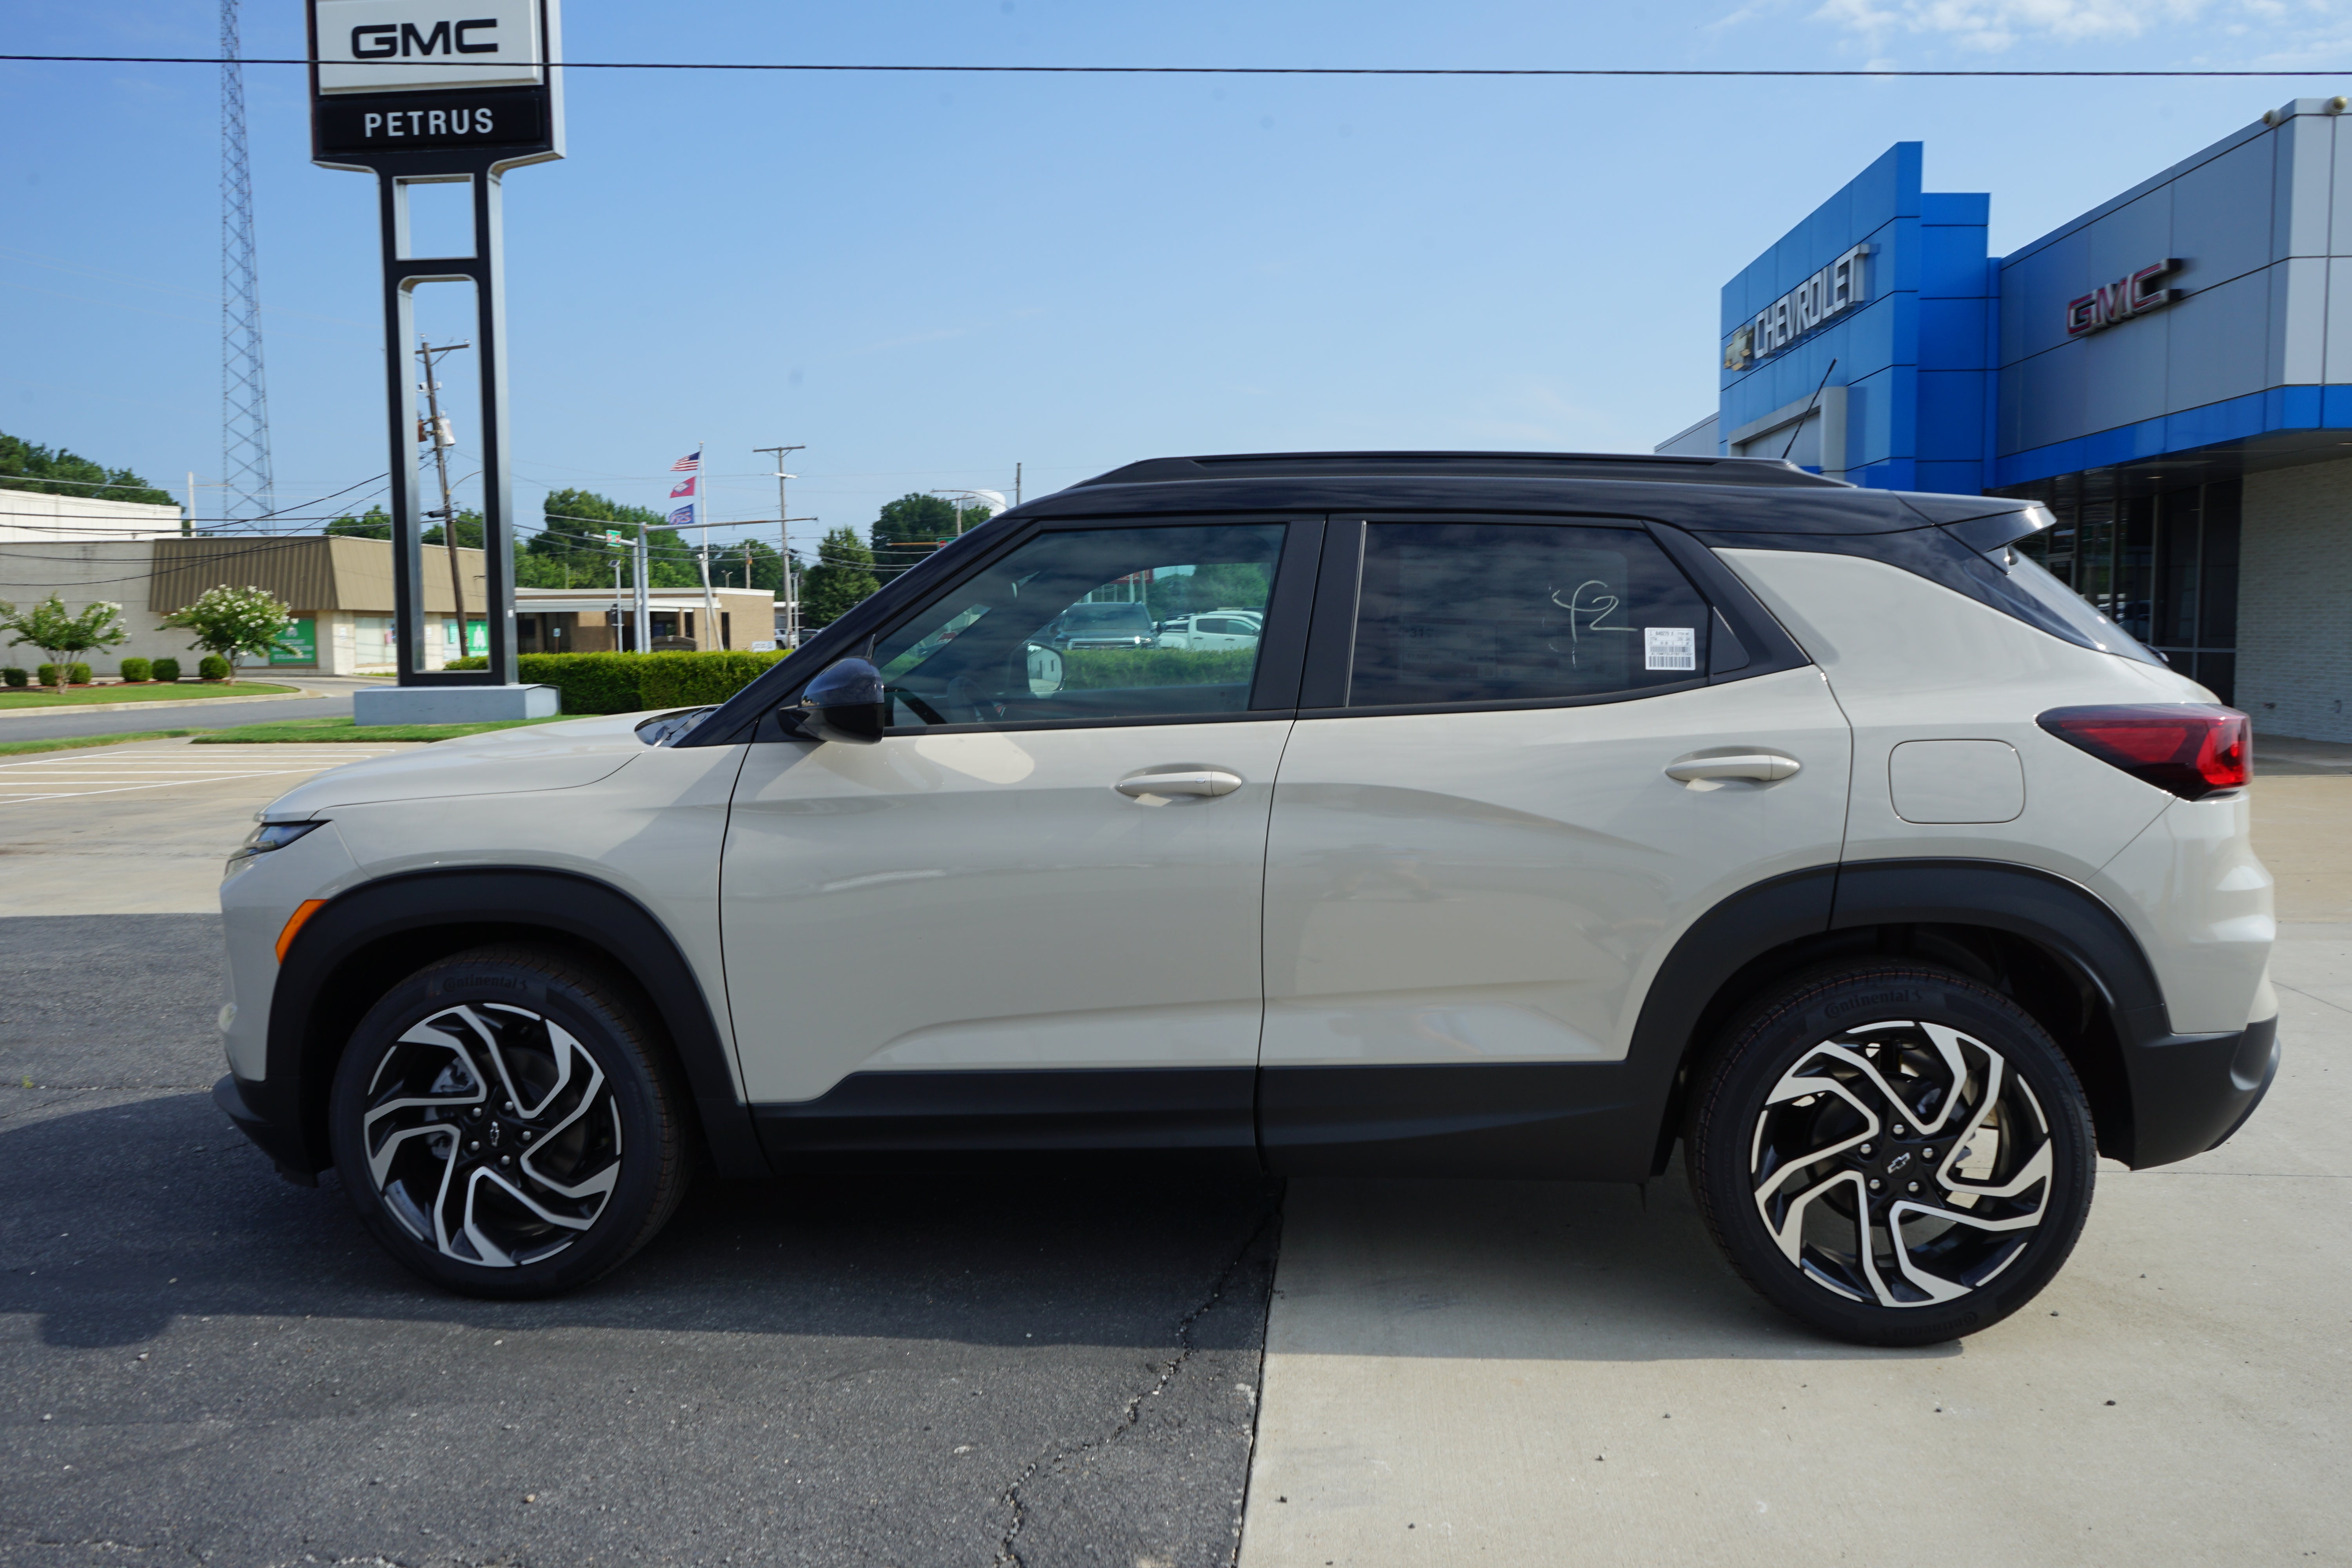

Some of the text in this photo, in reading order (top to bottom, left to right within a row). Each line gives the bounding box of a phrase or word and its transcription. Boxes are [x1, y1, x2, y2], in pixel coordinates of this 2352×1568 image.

[352, 18, 498, 58] GMC
[365, 108, 494, 137] PETRUS
[1754, 243, 1871, 359] CHEVROLET
[2068, 258, 2176, 337] GMC
[442, 974, 517, 992] Continental
[1824, 989, 1909, 1018] Continental
